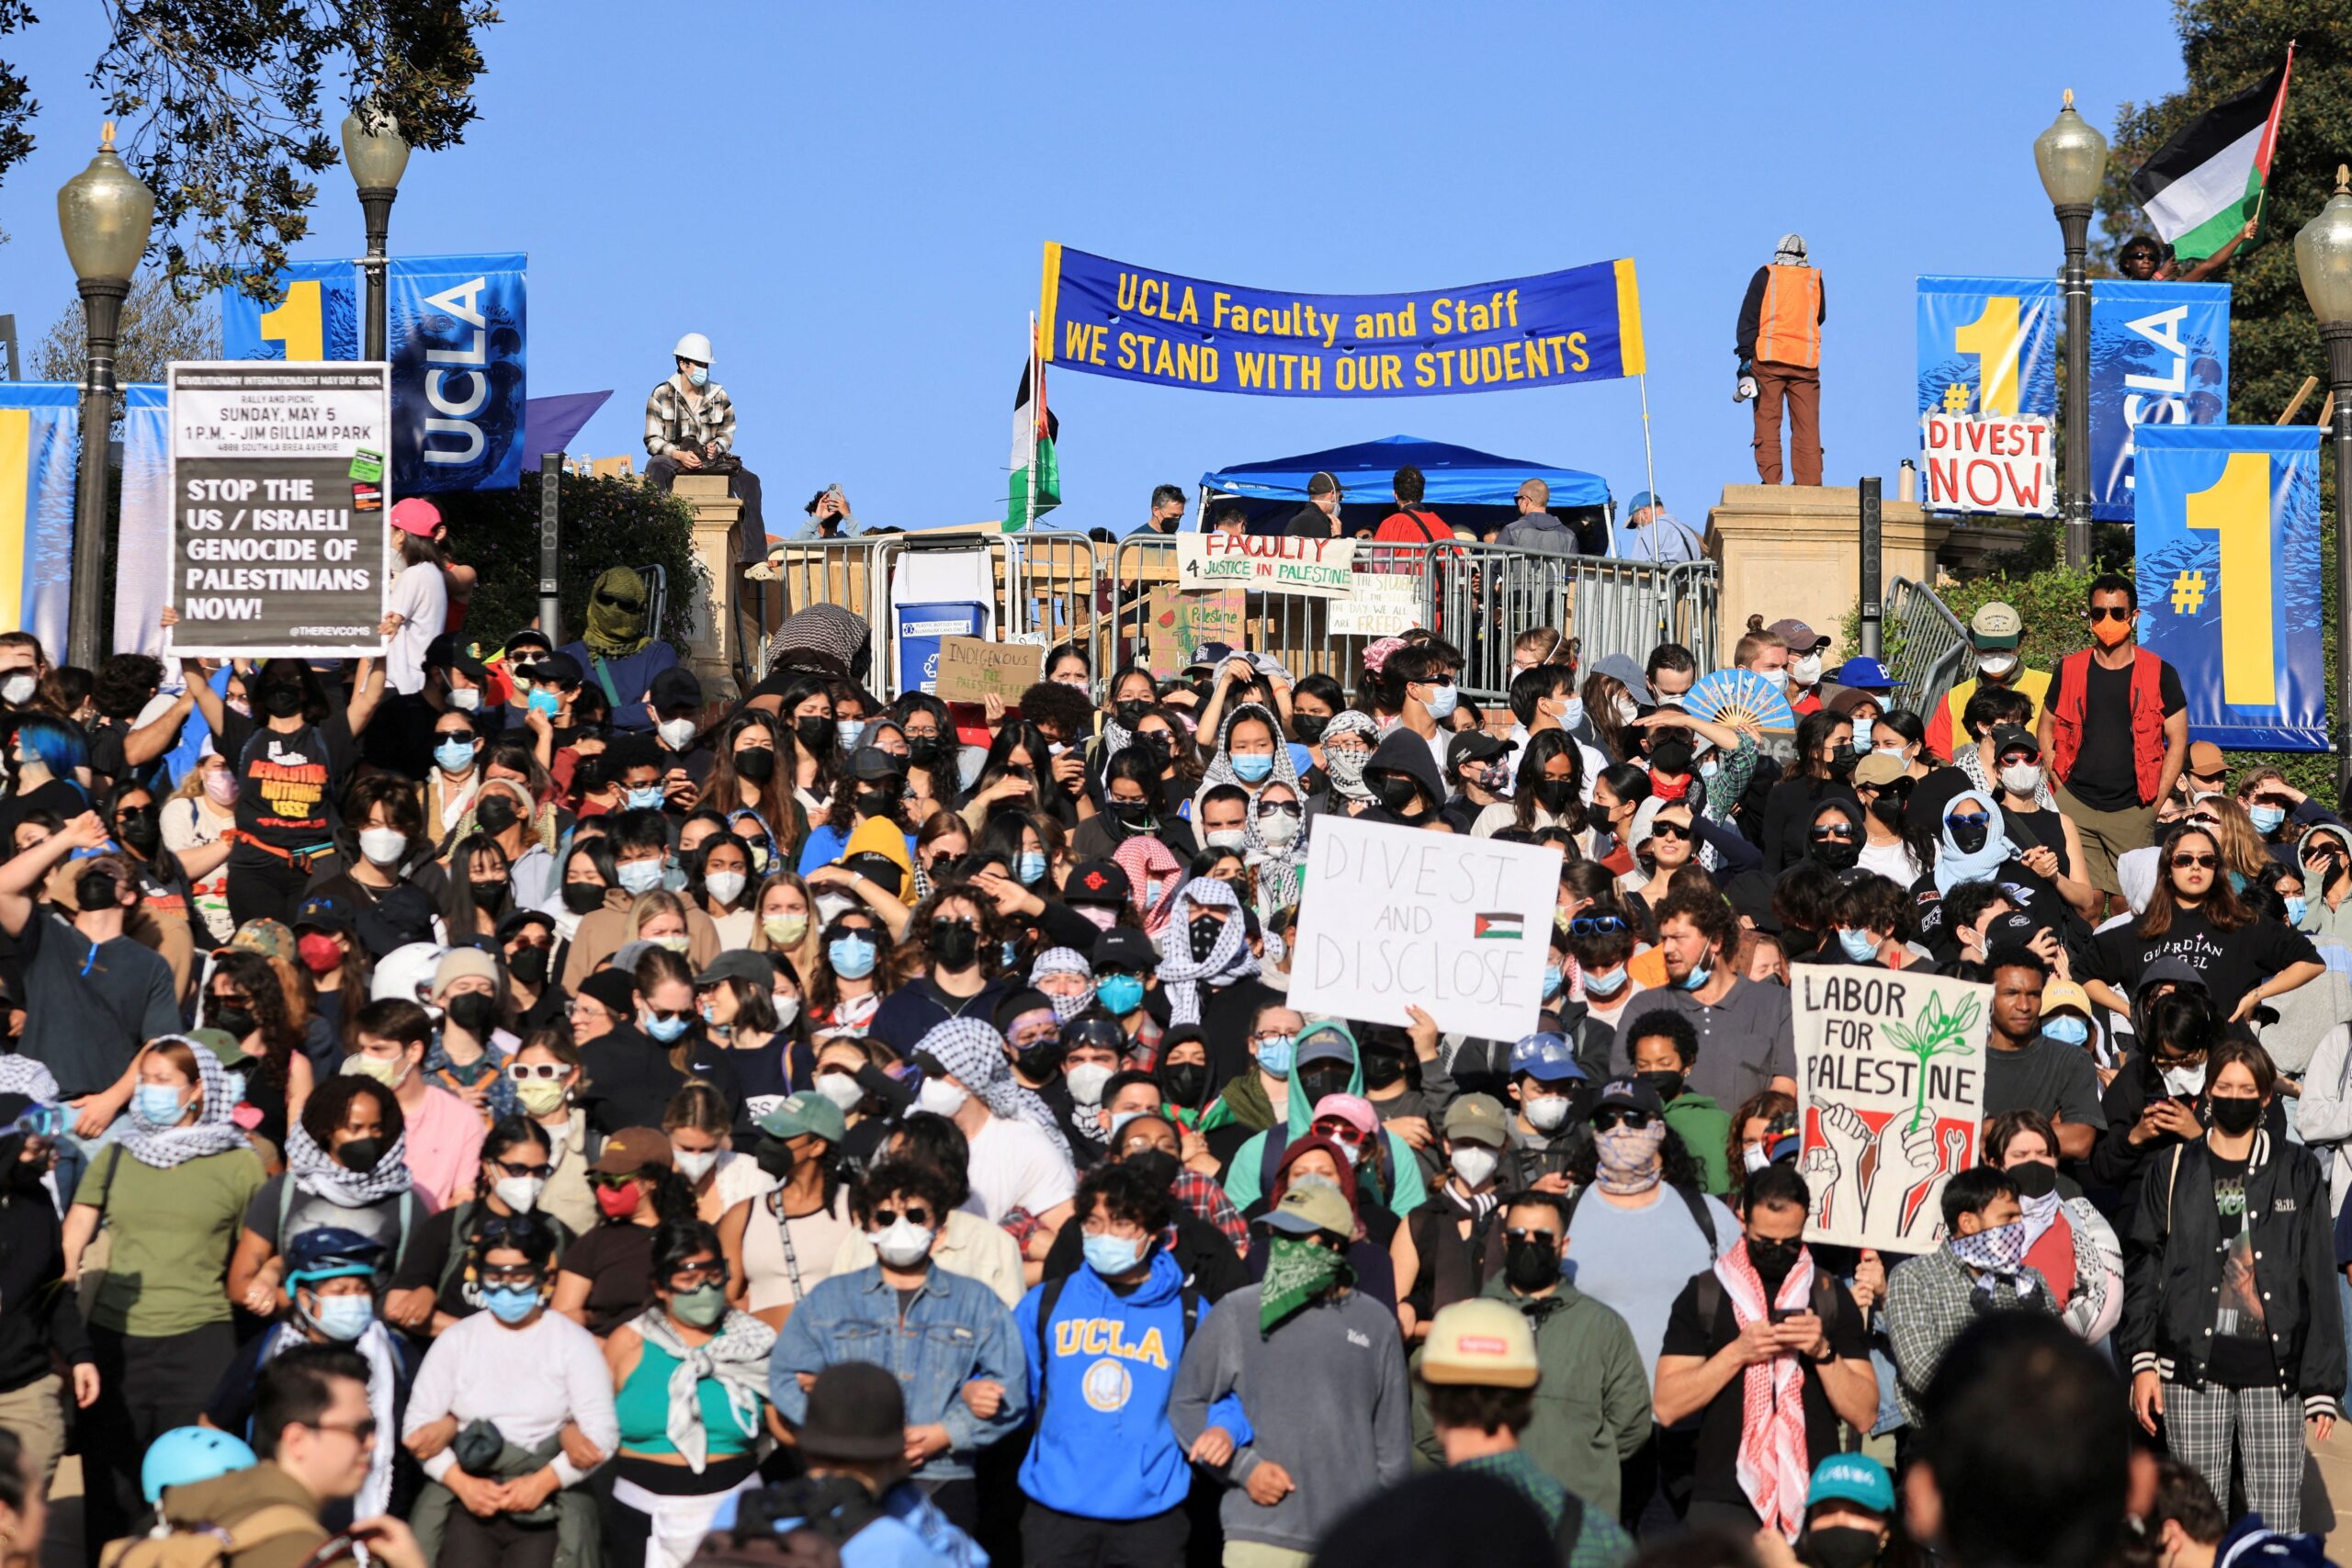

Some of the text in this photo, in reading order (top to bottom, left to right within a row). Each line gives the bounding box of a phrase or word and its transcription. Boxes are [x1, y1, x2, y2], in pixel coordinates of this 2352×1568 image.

[1117, 273, 1518, 348] UCLA Faculty and Staff
[1066, 321, 1589, 391] WE STAND WITH OUR STUDENTS
[244, 376, 318, 386] INTERNATIONALIST
[321, 376, 337, 386] MAY
[338, 376, 356, 386] DAY
[357, 376, 381, 386] 2024
[424, 276, 487, 465] UCLA
[241, 395, 314, 404] RALLY AND PICNIC
[220, 408, 336, 423] SUNDAY, MAY 5
[186, 426, 192, 440] 1
[196, 426, 226, 440] P.M.
[240, 426, 266, 440] JIM
[270, 426, 330, 440] GILLIAM
[334, 426, 371, 440] PARK
[1929, 420, 2046, 457] DIVEST
[242, 443, 268, 451] SOUTH
[269, 443, 279, 451] LA
[282, 443, 304, 451] BREA
[306, 443, 338, 451] AVENUE
[187, 479, 314, 502] STOP THE
[1929, 457, 2042, 507] NOW
[187, 509, 348, 531] US / ISRAELI
[187, 538, 358, 561] GENOCIDE OF
[1206, 535, 1329, 562] FACULTY
[186, 569, 370, 591] PALESTINIANS
[1186, 559, 1351, 585] 4 JUSTICE IN PALESTINE
[185, 598, 263, 620] NOW!
[1350, 604, 1367, 614] DAY
[1374, 605, 1385, 615] WE
[289, 626, 370, 637] @THEREVCOMS
[1357, 615, 1402, 633] FREED
[948, 643, 1028, 668] INDIGENOUS
[1877, 664, 1890, 680] B
[1325, 833, 1518, 908] DIVEST
[1374, 905, 1432, 934] AND
[2143, 939, 2223, 963] GUARDIAN
[1315, 932, 1524, 1009] DISCLOSE
[1804, 975, 1906, 1018] LABOR
[1825, 1019, 1873, 1050] FOR
[1055, 1317, 1169, 1371] UCLA
